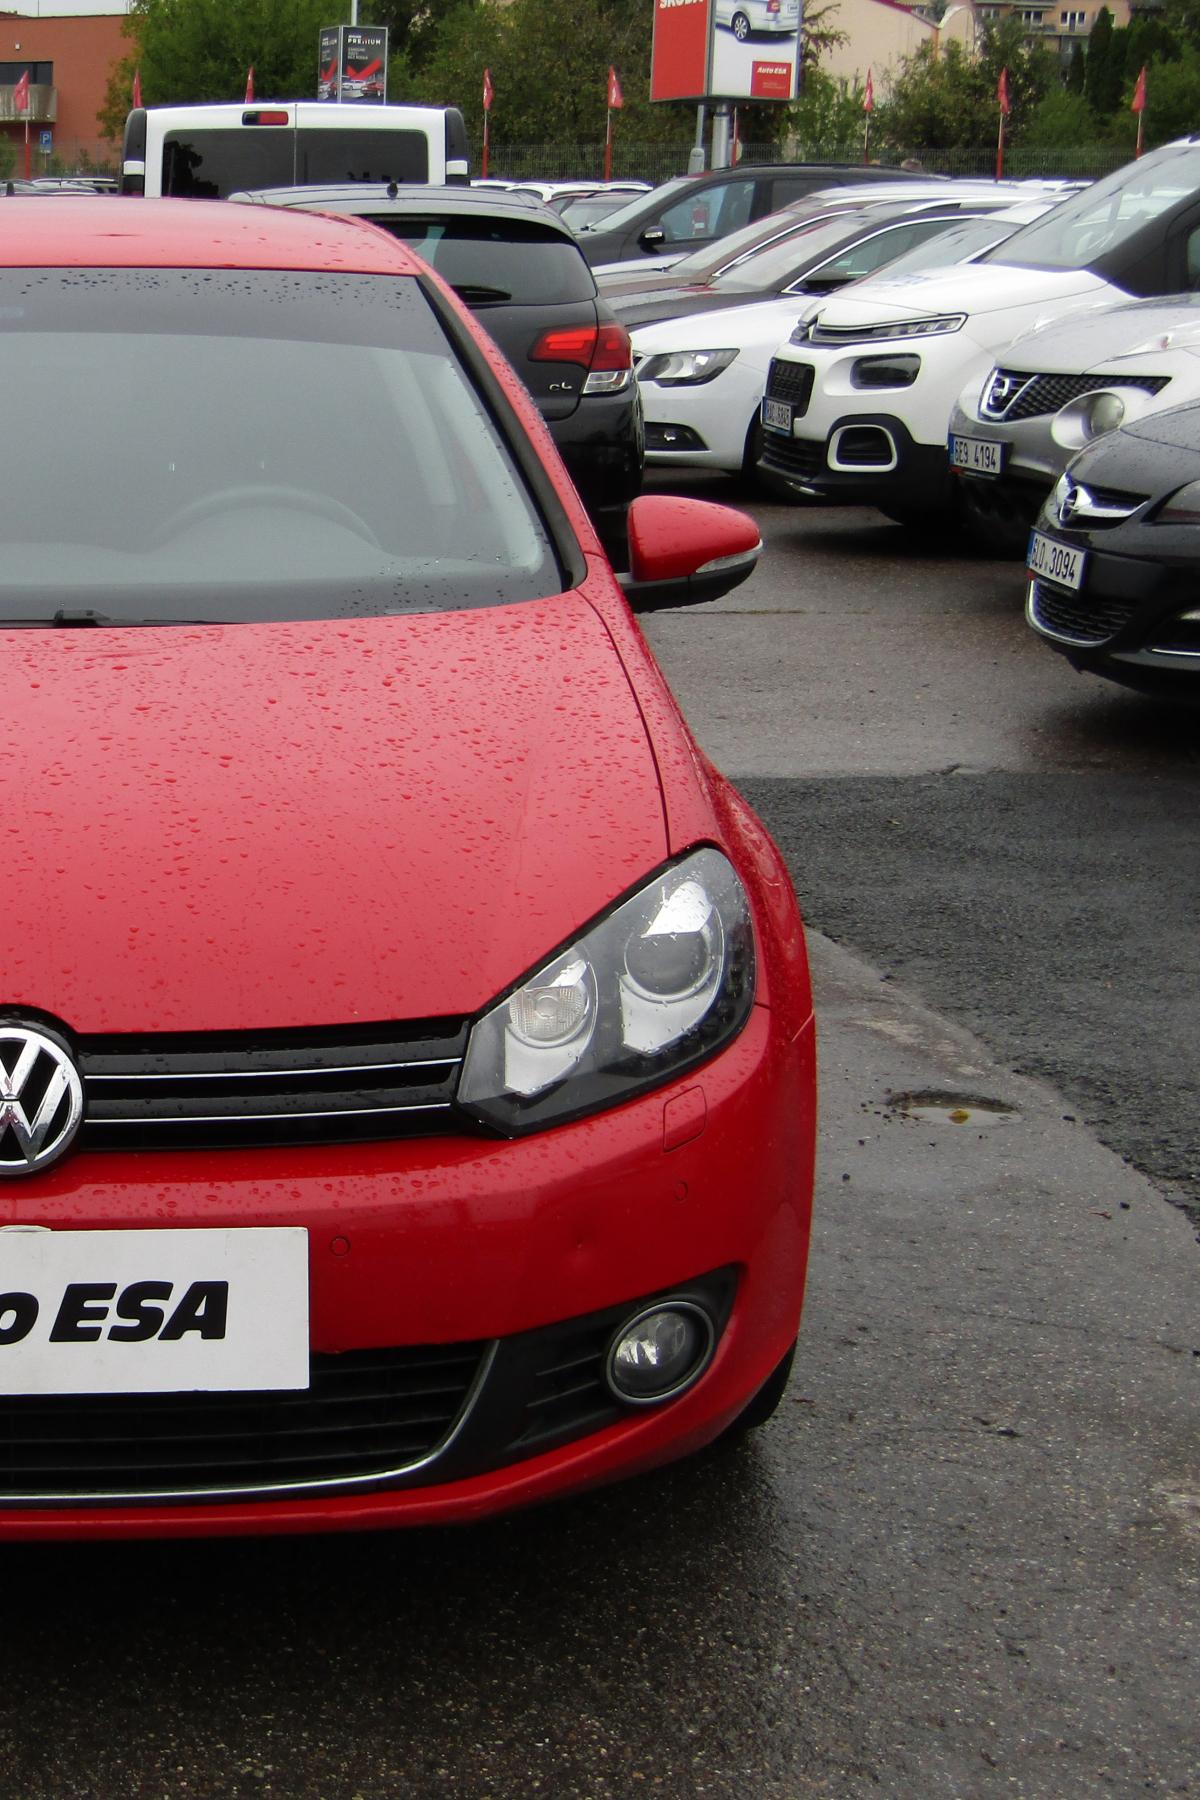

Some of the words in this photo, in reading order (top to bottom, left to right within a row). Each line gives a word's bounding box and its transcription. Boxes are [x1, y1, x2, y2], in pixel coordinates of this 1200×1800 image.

[974, 444, 997, 470] 4194
[1049, 546, 1077, 582] 3094
[48, 1280, 229, 1343] ESA
